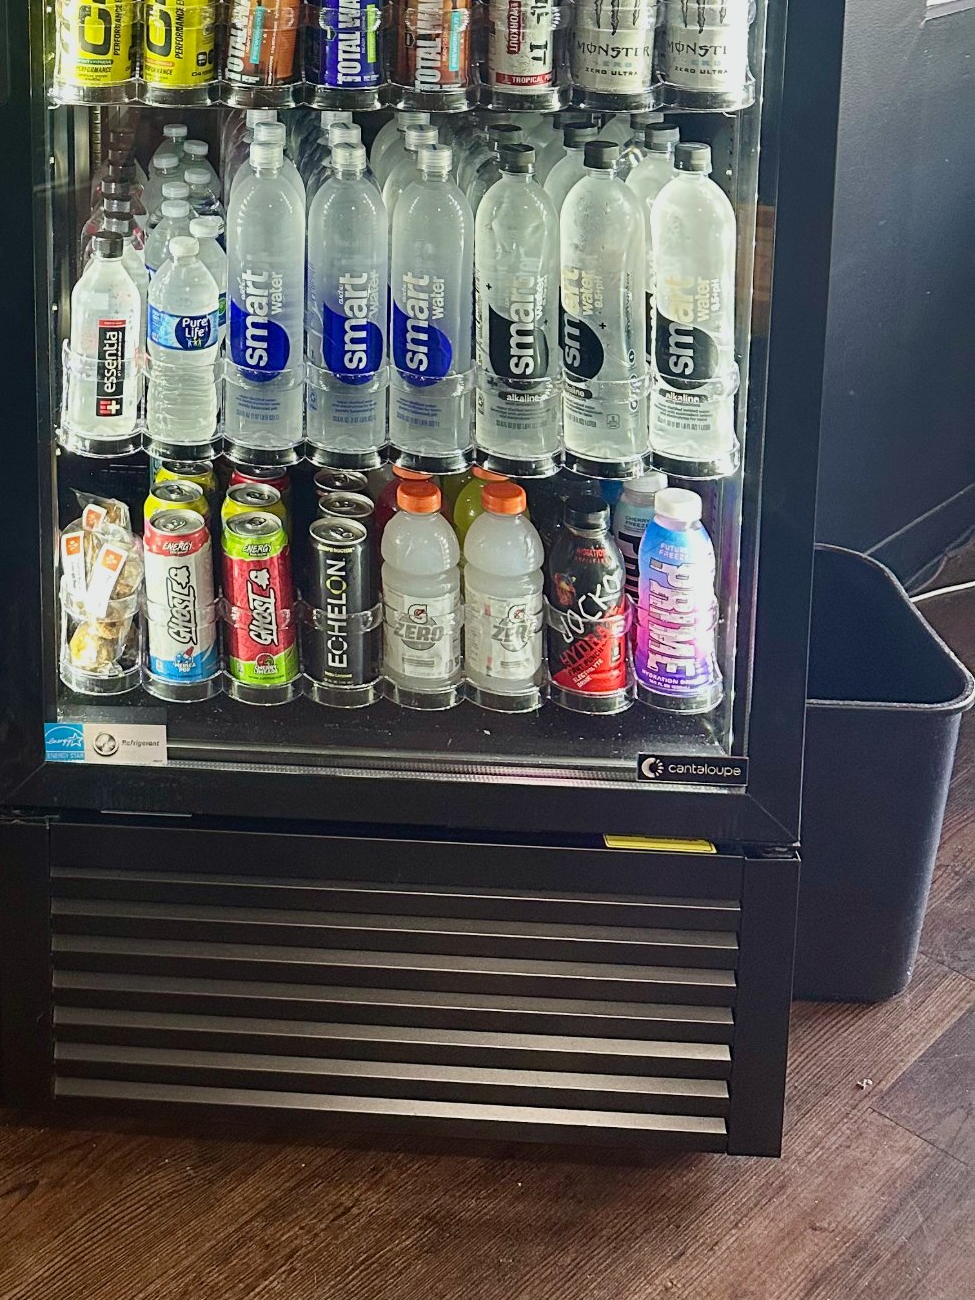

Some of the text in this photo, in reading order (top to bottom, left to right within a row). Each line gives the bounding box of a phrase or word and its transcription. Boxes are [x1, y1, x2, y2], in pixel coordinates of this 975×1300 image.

[113, 3, 123, 56] PERFORMANCE
[175, 4, 184, 59] PERFORMANCE
[577, 42, 650, 58] MONSTER
[337, 31, 361, 84] TOTAL
[415, 38, 441, 92] TOTAL
[271, 271, 283, 315] water
[430, 276, 445, 320] water
[582, 271, 594, 316] water
[697, 276, 710, 322] water
[182, 317, 208, 328] Pure
[185, 327, 205, 338] Life
[245, 269, 269, 367] smart
[344, 272, 368, 370] smart
[406, 271, 429, 372] smart
[509, 274, 535, 376] smart
[668, 276, 694, 376] smart
[103, 330, 118, 393] essentia
[506, 393, 540, 402] alkaline
[665, 392, 700, 404] alkaline
[163, 542, 193, 551] ENERGY
[243, 544, 272, 554] ENERGY
[166, 577, 197, 645] GHOST
[247, 579, 279, 646] GHOST
[325, 559, 348, 668] ECHELON
[563, 570, 623, 643] JOCKO
[394, 624, 445, 642] ZERO
[121, 739, 160, 747] Refrigerant
[668, 764, 742, 776] cantaloupe
